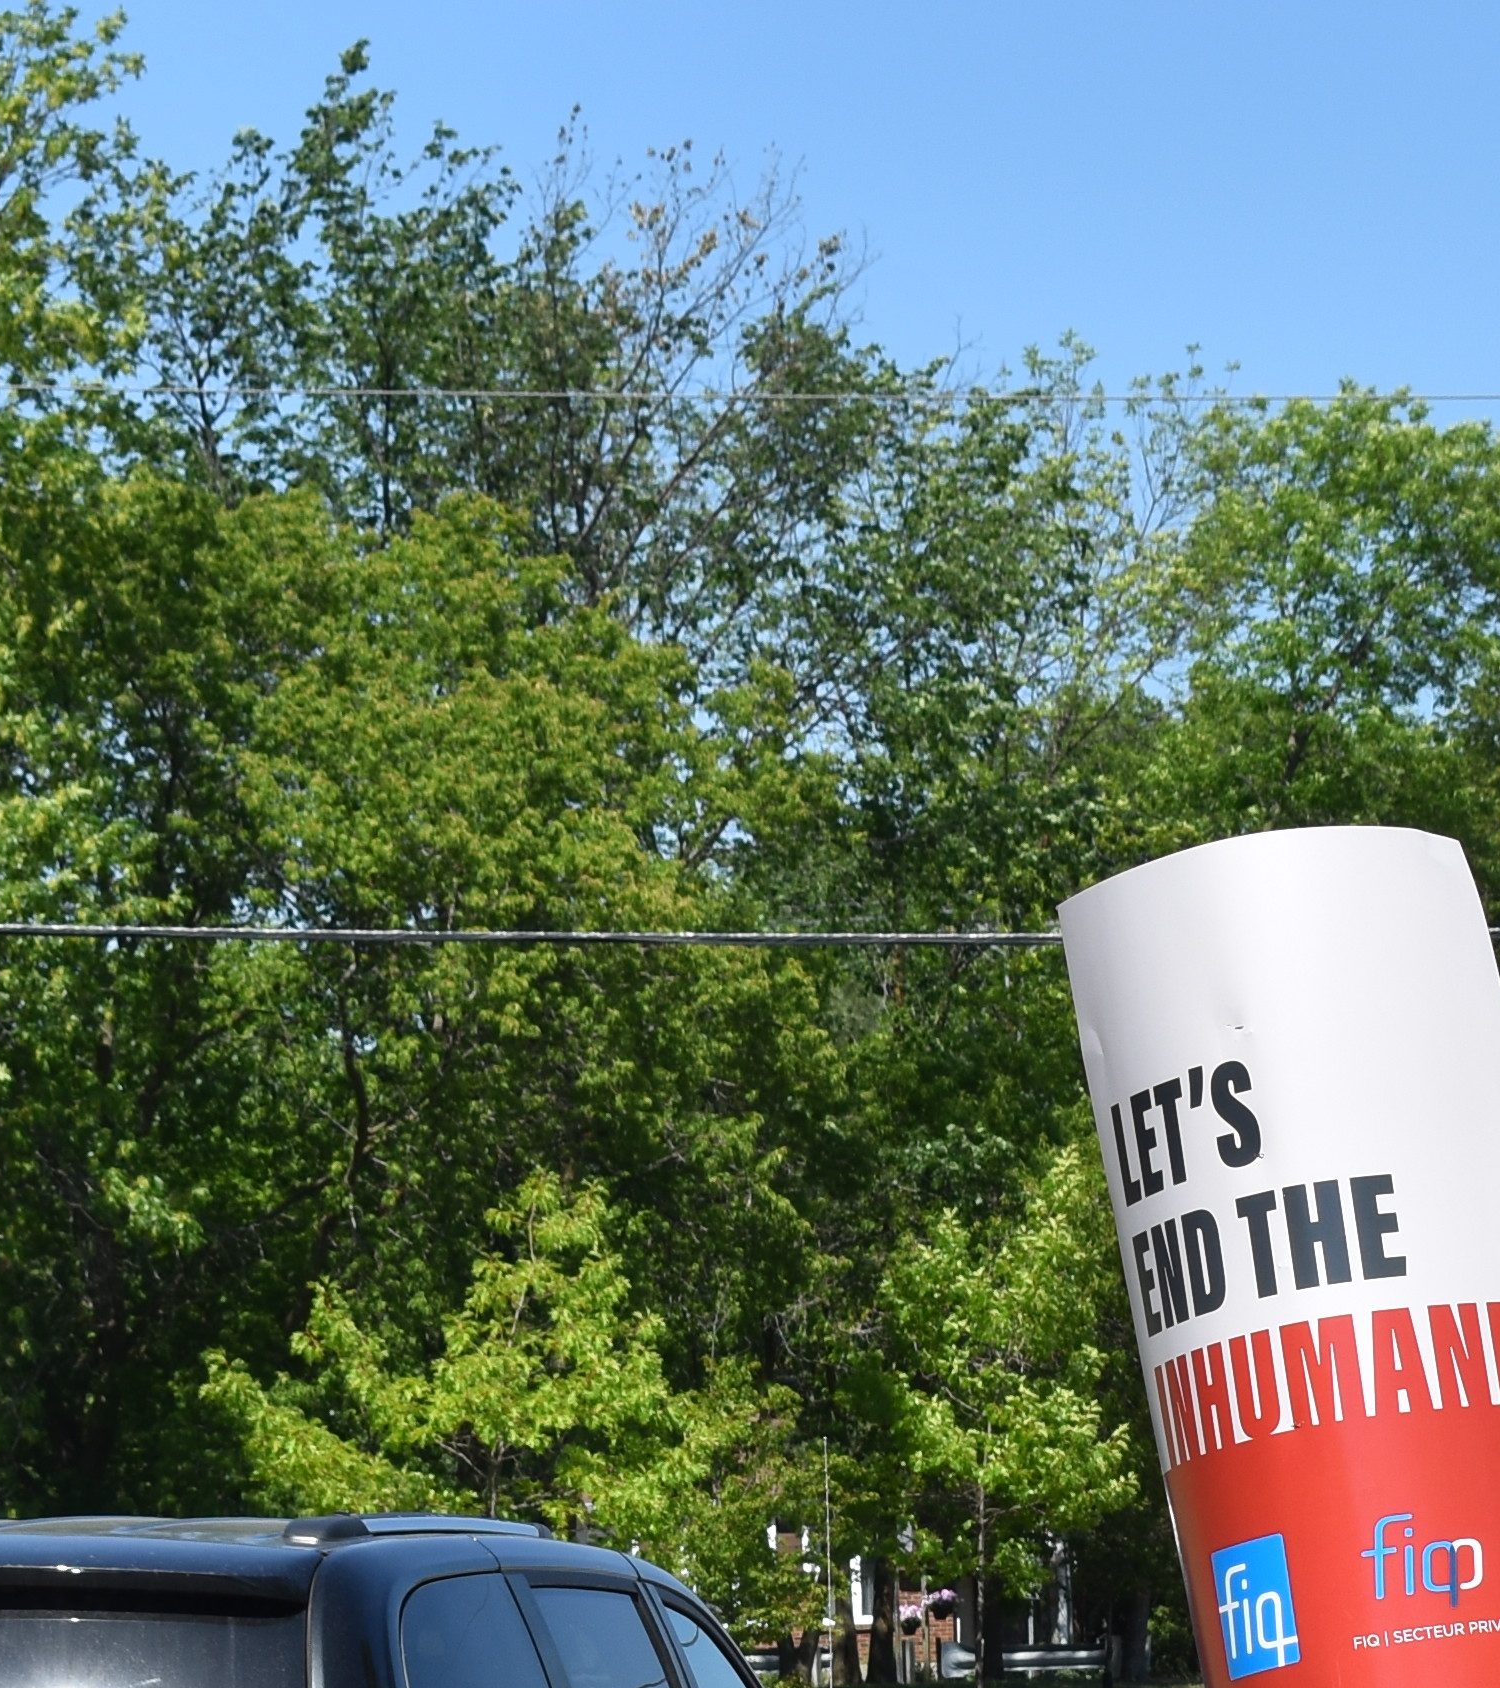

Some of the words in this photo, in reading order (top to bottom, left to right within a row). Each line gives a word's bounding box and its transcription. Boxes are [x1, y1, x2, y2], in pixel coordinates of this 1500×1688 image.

[1111, 1060, 1263, 1206] LET'S
[1132, 1208, 1227, 1337] END
[1235, 1174, 1407, 1298] THE
[1353, 1635, 1381, 1650] FIQ
[1393, 1622, 1465, 1644] SECTEUR
